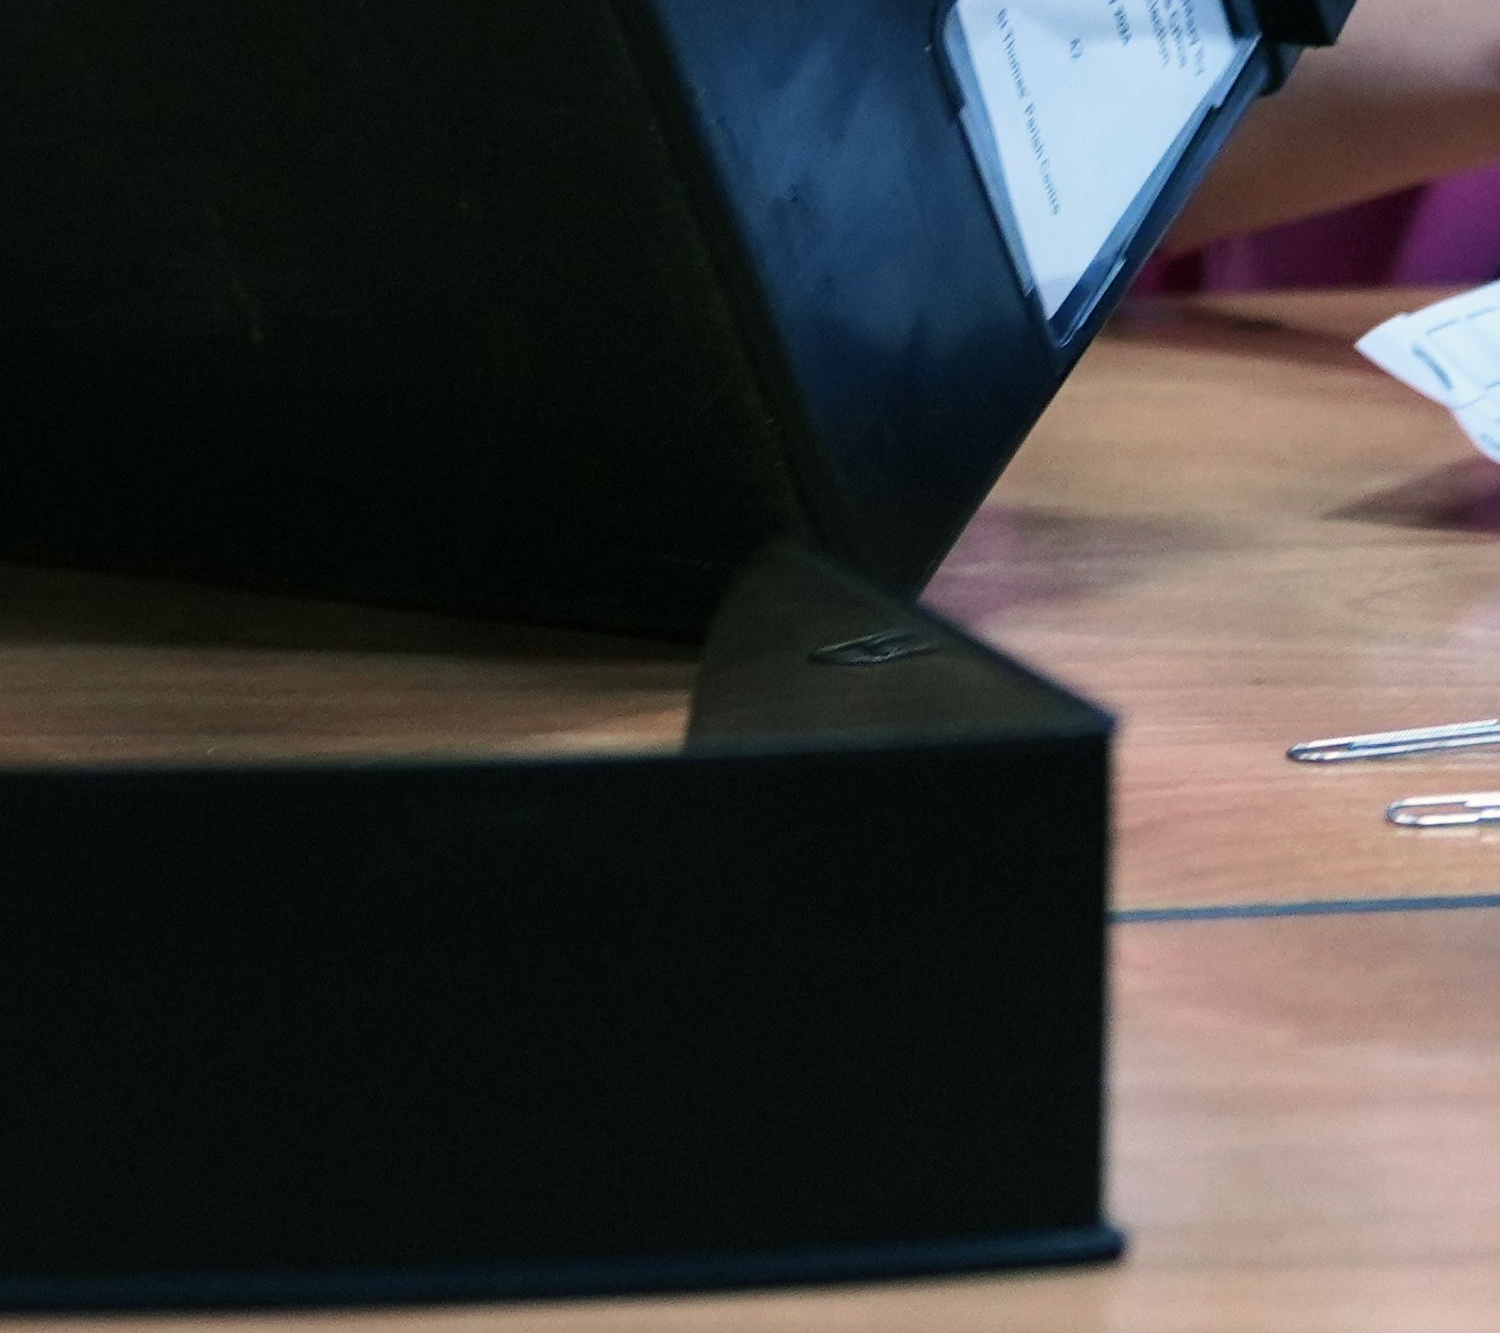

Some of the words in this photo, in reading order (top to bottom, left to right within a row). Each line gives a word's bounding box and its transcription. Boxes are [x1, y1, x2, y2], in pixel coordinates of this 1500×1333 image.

[1169, 10, 1187, 68] Crime
[996, 8, 1008, 30] St
[1024, 102, 1044, 160] Parish
[1040, 158, 1060, 216] Centre
